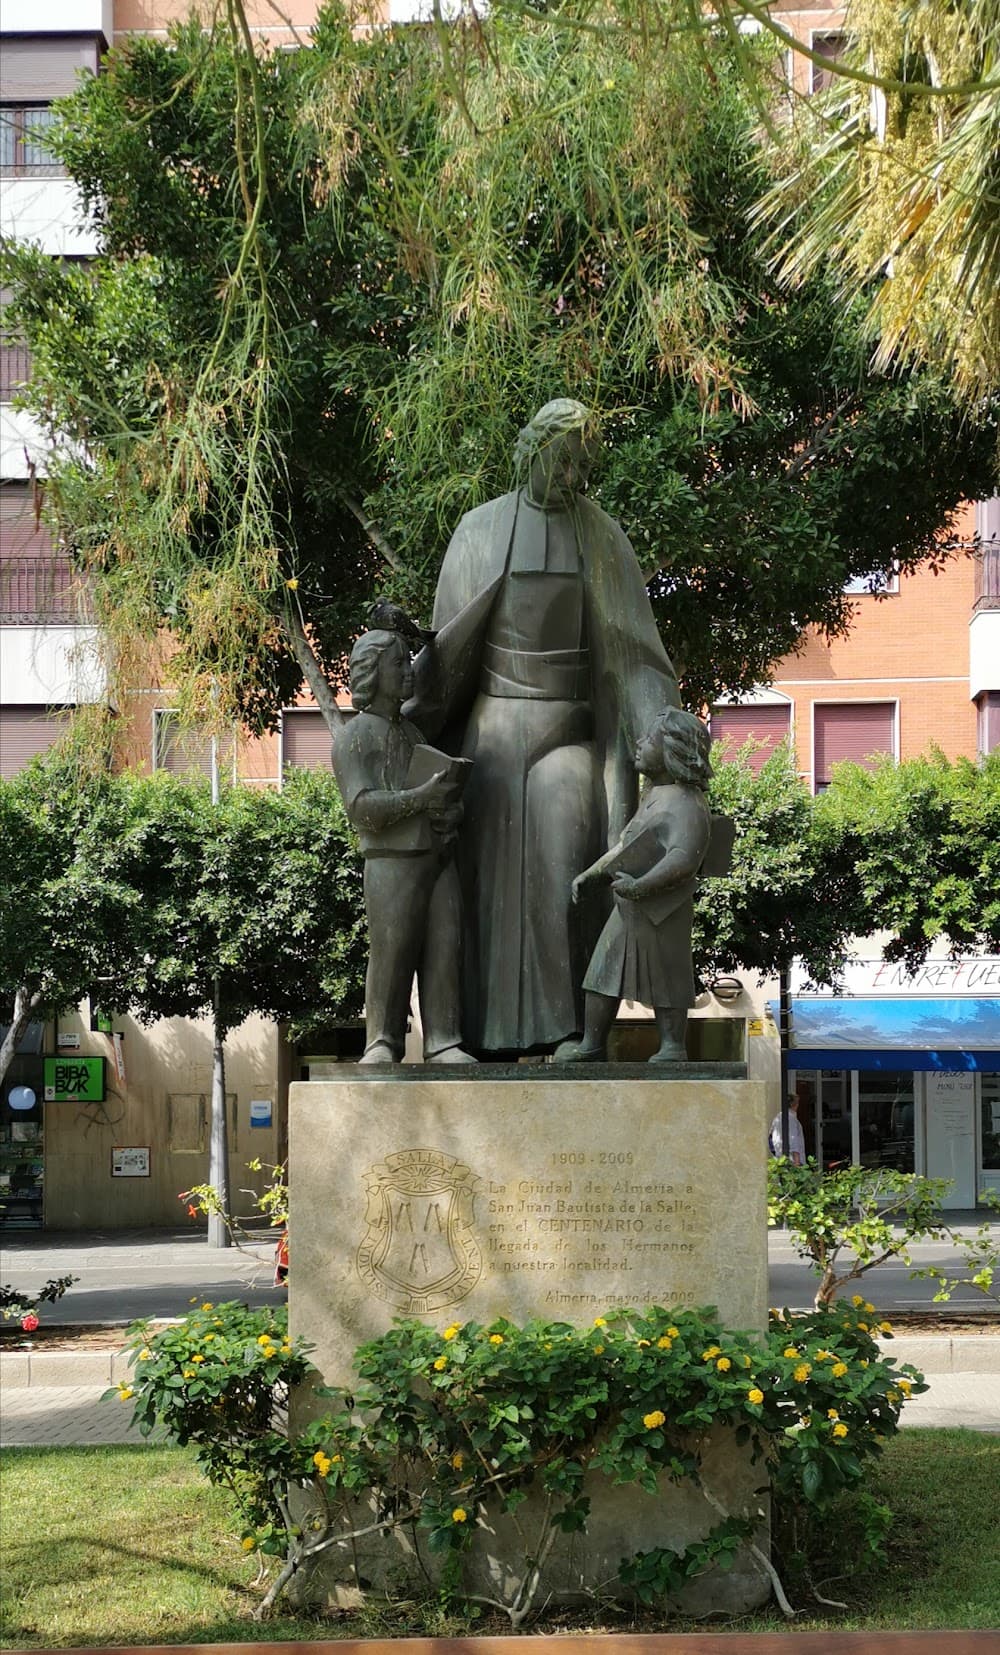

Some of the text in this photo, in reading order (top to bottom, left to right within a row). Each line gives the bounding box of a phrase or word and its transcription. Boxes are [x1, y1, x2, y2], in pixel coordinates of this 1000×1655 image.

[872, 962, 1000, 988] ENREFUE
[56, 1065, 90, 1080] BIBA
[56, 1079, 88, 1094] BUK
[551, 1152, 586, 1166] 1909
[599, 1152, 634, 1166] 2009
[489, 1180, 506, 1194] La
[518, 1180, 573, 1194] Ciudad
[584, 1180, 602, 1194] de
[686, 1184, 693, 1194] a
[488, 1199, 697, 1216] San Juan Bautista de la Salle,
[489, 1219, 694, 1233] en el CENTENARIO de la
[488, 1238, 696, 1254] llegada de los Hermanos
[489, 1257, 633, 1271] a nuestra localidad.
[605, 1294, 640, 1305] mayo
[643, 1290, 659, 1303] de
[661, 1291, 695, 1303] 2009
